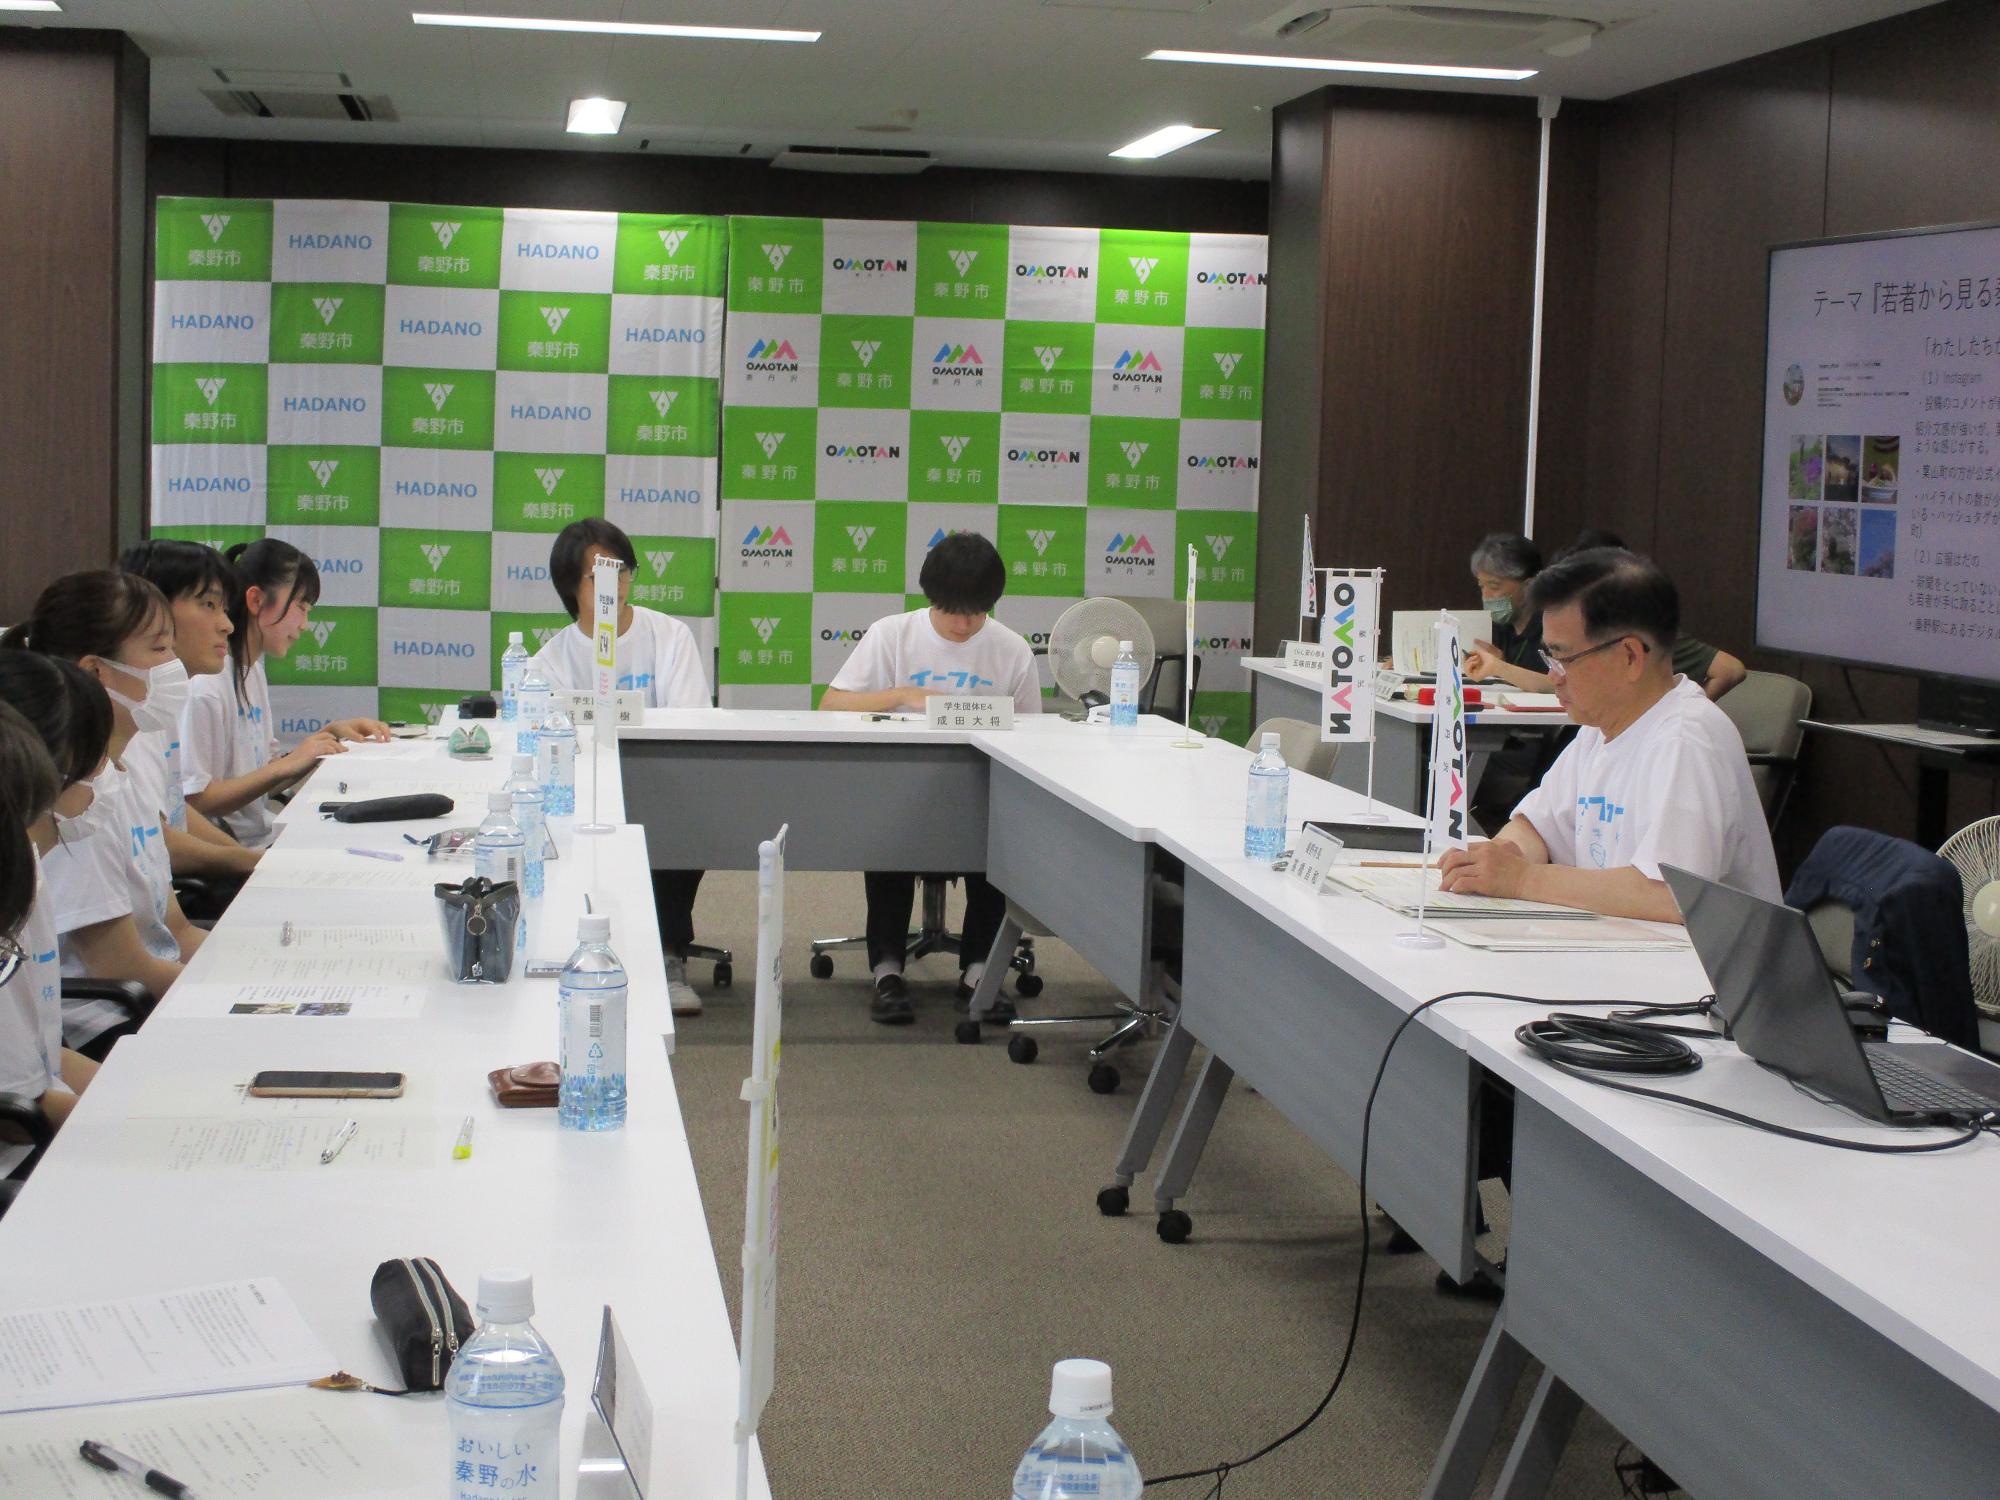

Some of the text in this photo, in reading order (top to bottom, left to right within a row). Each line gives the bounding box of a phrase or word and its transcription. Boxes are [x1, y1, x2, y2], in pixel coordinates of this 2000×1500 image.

[289, 234, 372, 250] HADANO
[188, 250, 241, 267] 秦野市
[517, 243, 600, 260] HADANO
[417, 256, 470, 273] 秦野市
[643, 264, 696, 281] 秦野市
[834, 258, 907, 273] OMOTAN
[1016, 264, 1088, 279] OMOTAN
[748, 276, 805, 294] 秦野市
[1197, 271, 1268, 286] OMOTAN
[933, 282, 990, 299] 秦野市
[1113, 288, 1170, 306] 秦野市
[170, 314, 255, 330] HADANO
[400, 319, 482, 337] HADANO
[299, 332, 353, 349] 秦野市
[626, 328, 706, 344] HADANO
[527, 341, 580, 359] 秦野市
[747, 362, 798, 373] OMOTAN
[932, 366, 983, 377] OMOTAN
[837, 371, 893, 389] 秦野市
[1019, 377, 1075, 394] 秦野市
[1113, 373, 1163, 384] OMOTAN
[1199, 385, 1254, 401] 秦野市
[283, 397, 366, 413] HADANO
[510, 405, 592, 421] HADANO
[184, 412, 237, 430] 秦野市
[411, 417, 464, 434] 秦野市
[636, 425, 688, 441] 秦野市
[826, 444, 900, 459] OMOTAN
[1008, 449, 1080, 464] OMOTAN
[1188, 455, 1258, 470] OMOTAN
[741, 464, 798, 482] 秦野市
[926, 468, 982, 484] 秦野市
[1105, 472, 1160, 489] 秦野市
[168, 477, 251, 493] HADANO
[395, 481, 478, 498] HADANO
[296, 494, 350, 512] 秦野市
[619, 488, 701, 504] HADANO
[522, 503, 575, 519] 秦野市
[742, 548, 793, 558] OMOTAN
[1105, 555, 1155, 566] OMOTAN
[831, 557, 888, 575] 秦野市
[1012, 561, 1068, 578] 秦野市
[408, 578, 461, 595] 秦野市
[632, 584, 685, 602] 秦野市
[393, 641, 476, 658] HADANO
[1193, 637, 1251, 650] MOTAN
[295, 655, 348, 672] 秦野市
[738, 648, 794, 665] 秦野市
[943, 702, 993, 711] 学生団体E4
[1448, 636, 1465, 840] OMOTAN
[458, 1437, 531, 1460] おいしい
[456, 1459, 538, 1489] 秦野の水
